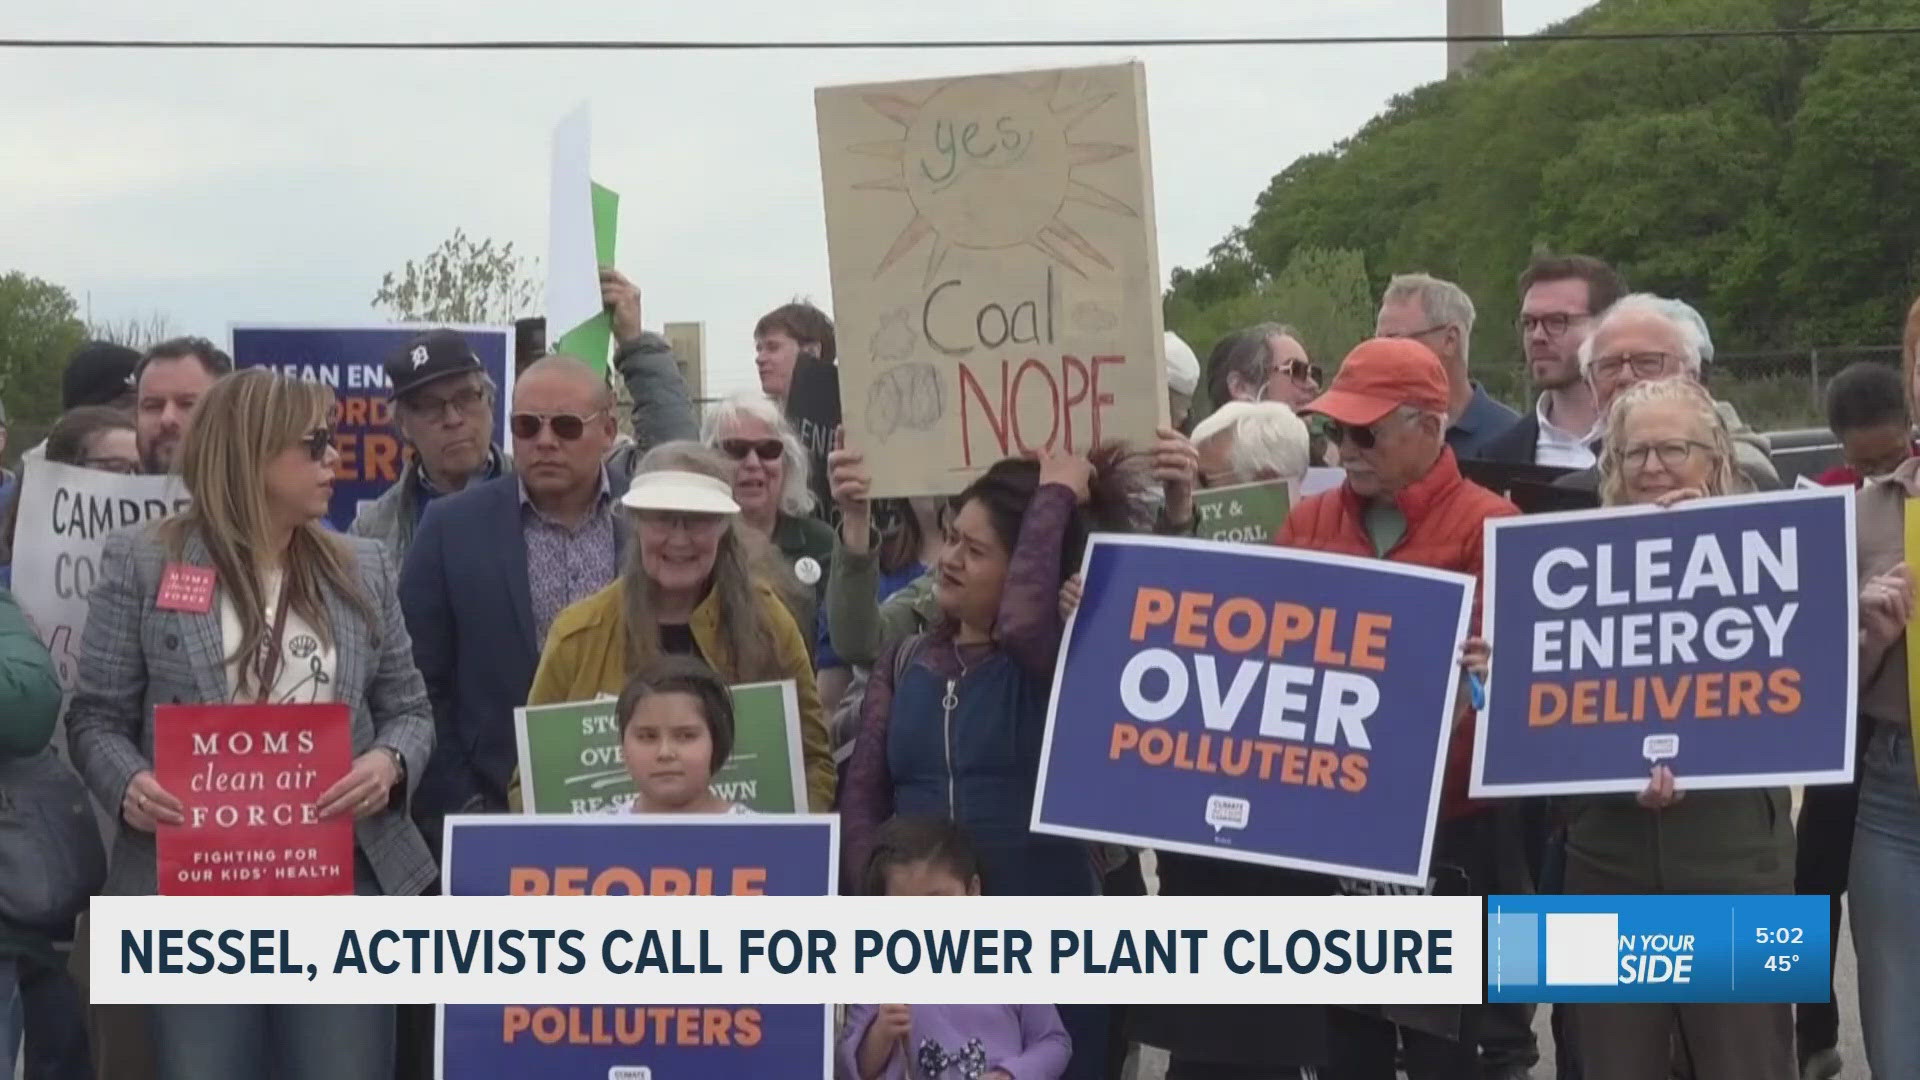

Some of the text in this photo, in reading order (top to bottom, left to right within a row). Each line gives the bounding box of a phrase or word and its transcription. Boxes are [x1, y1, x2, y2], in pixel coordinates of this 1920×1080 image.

[921, 115, 1020, 182] yes
[923, 265, 1054, 355] Coal
[347, 364, 394, 388] EN
[1229, 500, 1243, 517] &
[1213, 524, 1268, 543] COAL
[1532, 527, 1799, 611] CLEAN
[1129, 586, 1392, 671] PEOPLE
[1532, 603, 1799, 673] ENERGY
[1120, 648, 1380, 750] OVER
[1528, 668, 1802, 727] DELIVERS
[192, 730, 314, 755] MOMS
[1109, 723, 1370, 793] POLLUTERS
[191, 762, 317, 792] clean air
[192, 803, 319, 829] FORCE
[178, 865, 340, 882] OUR KIDS' HEALTH
[194, 848, 318, 864] FIGHTING FOR
[503, 1006, 762, 1047] POLLUTERS
